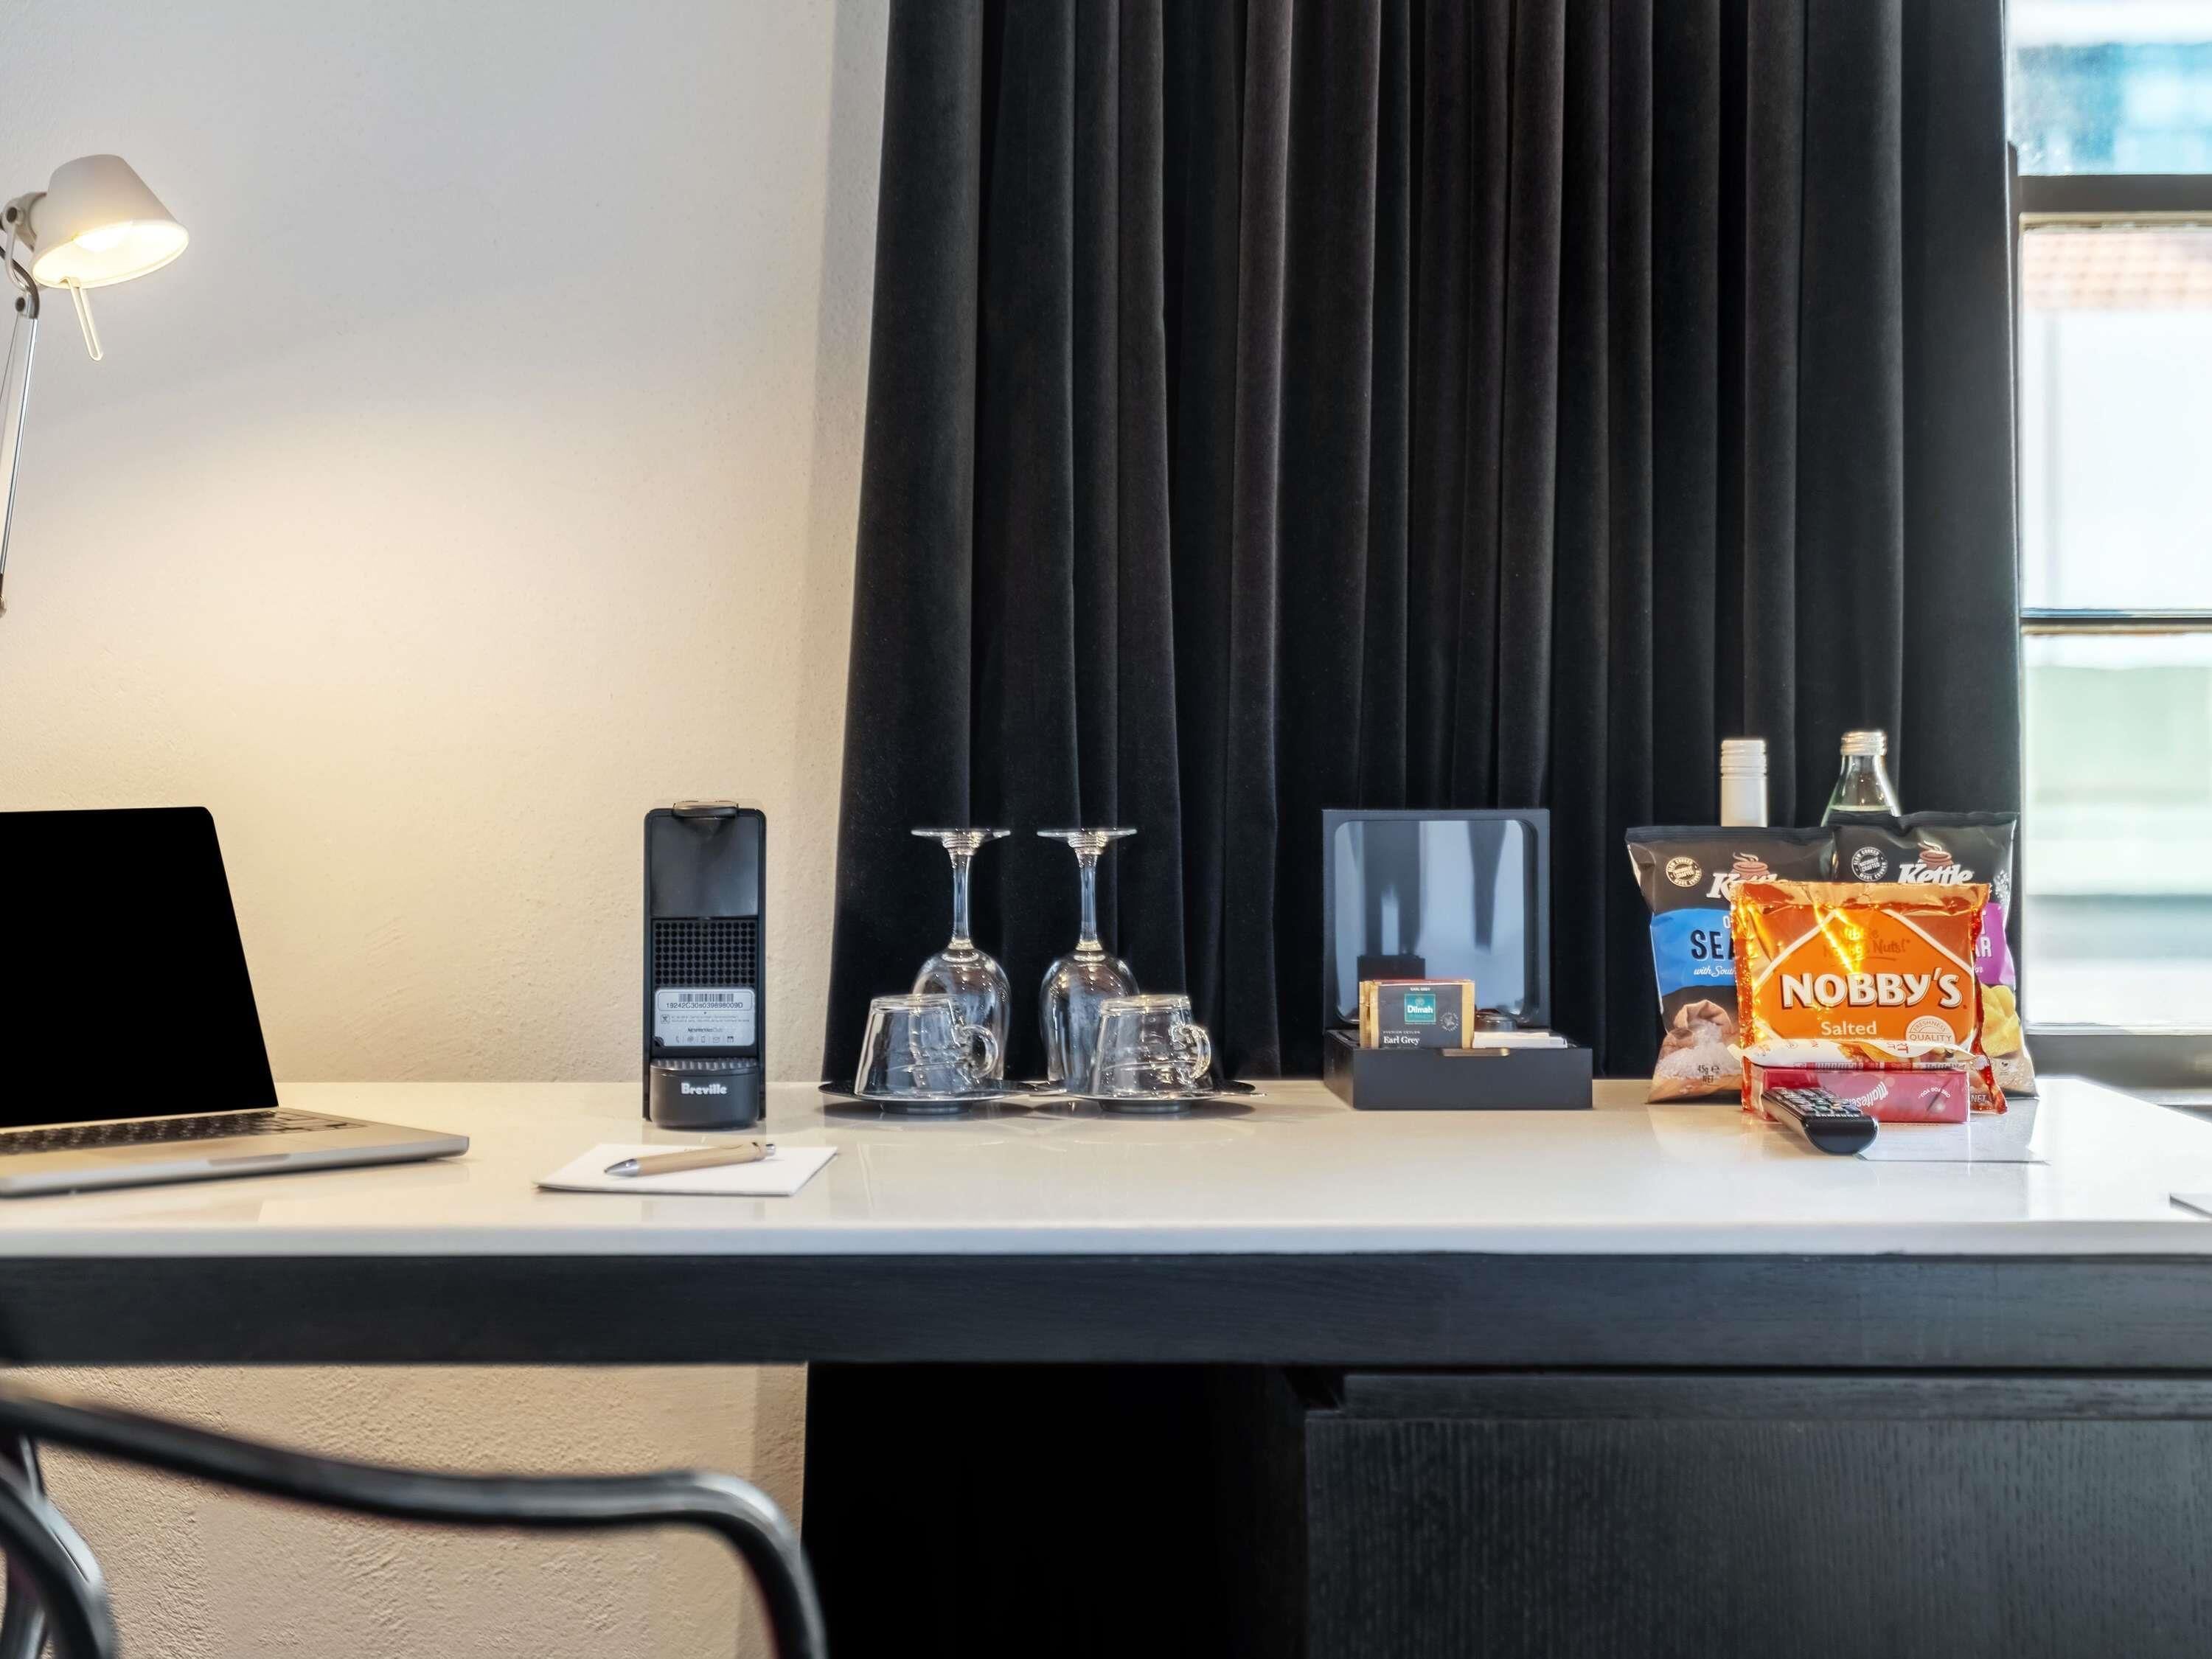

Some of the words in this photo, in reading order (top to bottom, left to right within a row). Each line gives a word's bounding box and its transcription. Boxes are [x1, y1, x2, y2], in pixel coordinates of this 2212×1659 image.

[1897, 863, 1974, 884] Kettle
[1781, 967, 1963, 1009] NOBBY'S
[1407, 1004, 1433, 1014] Dilmah
[1820, 1020, 1877, 1036] Salted
[1383, 1035, 1400, 1044] Earl
[1401, 1035, 1420, 1046] Grey
[1909, 1033, 1952, 1042] QUALITY
[681, 1082, 728, 1095] Breville
